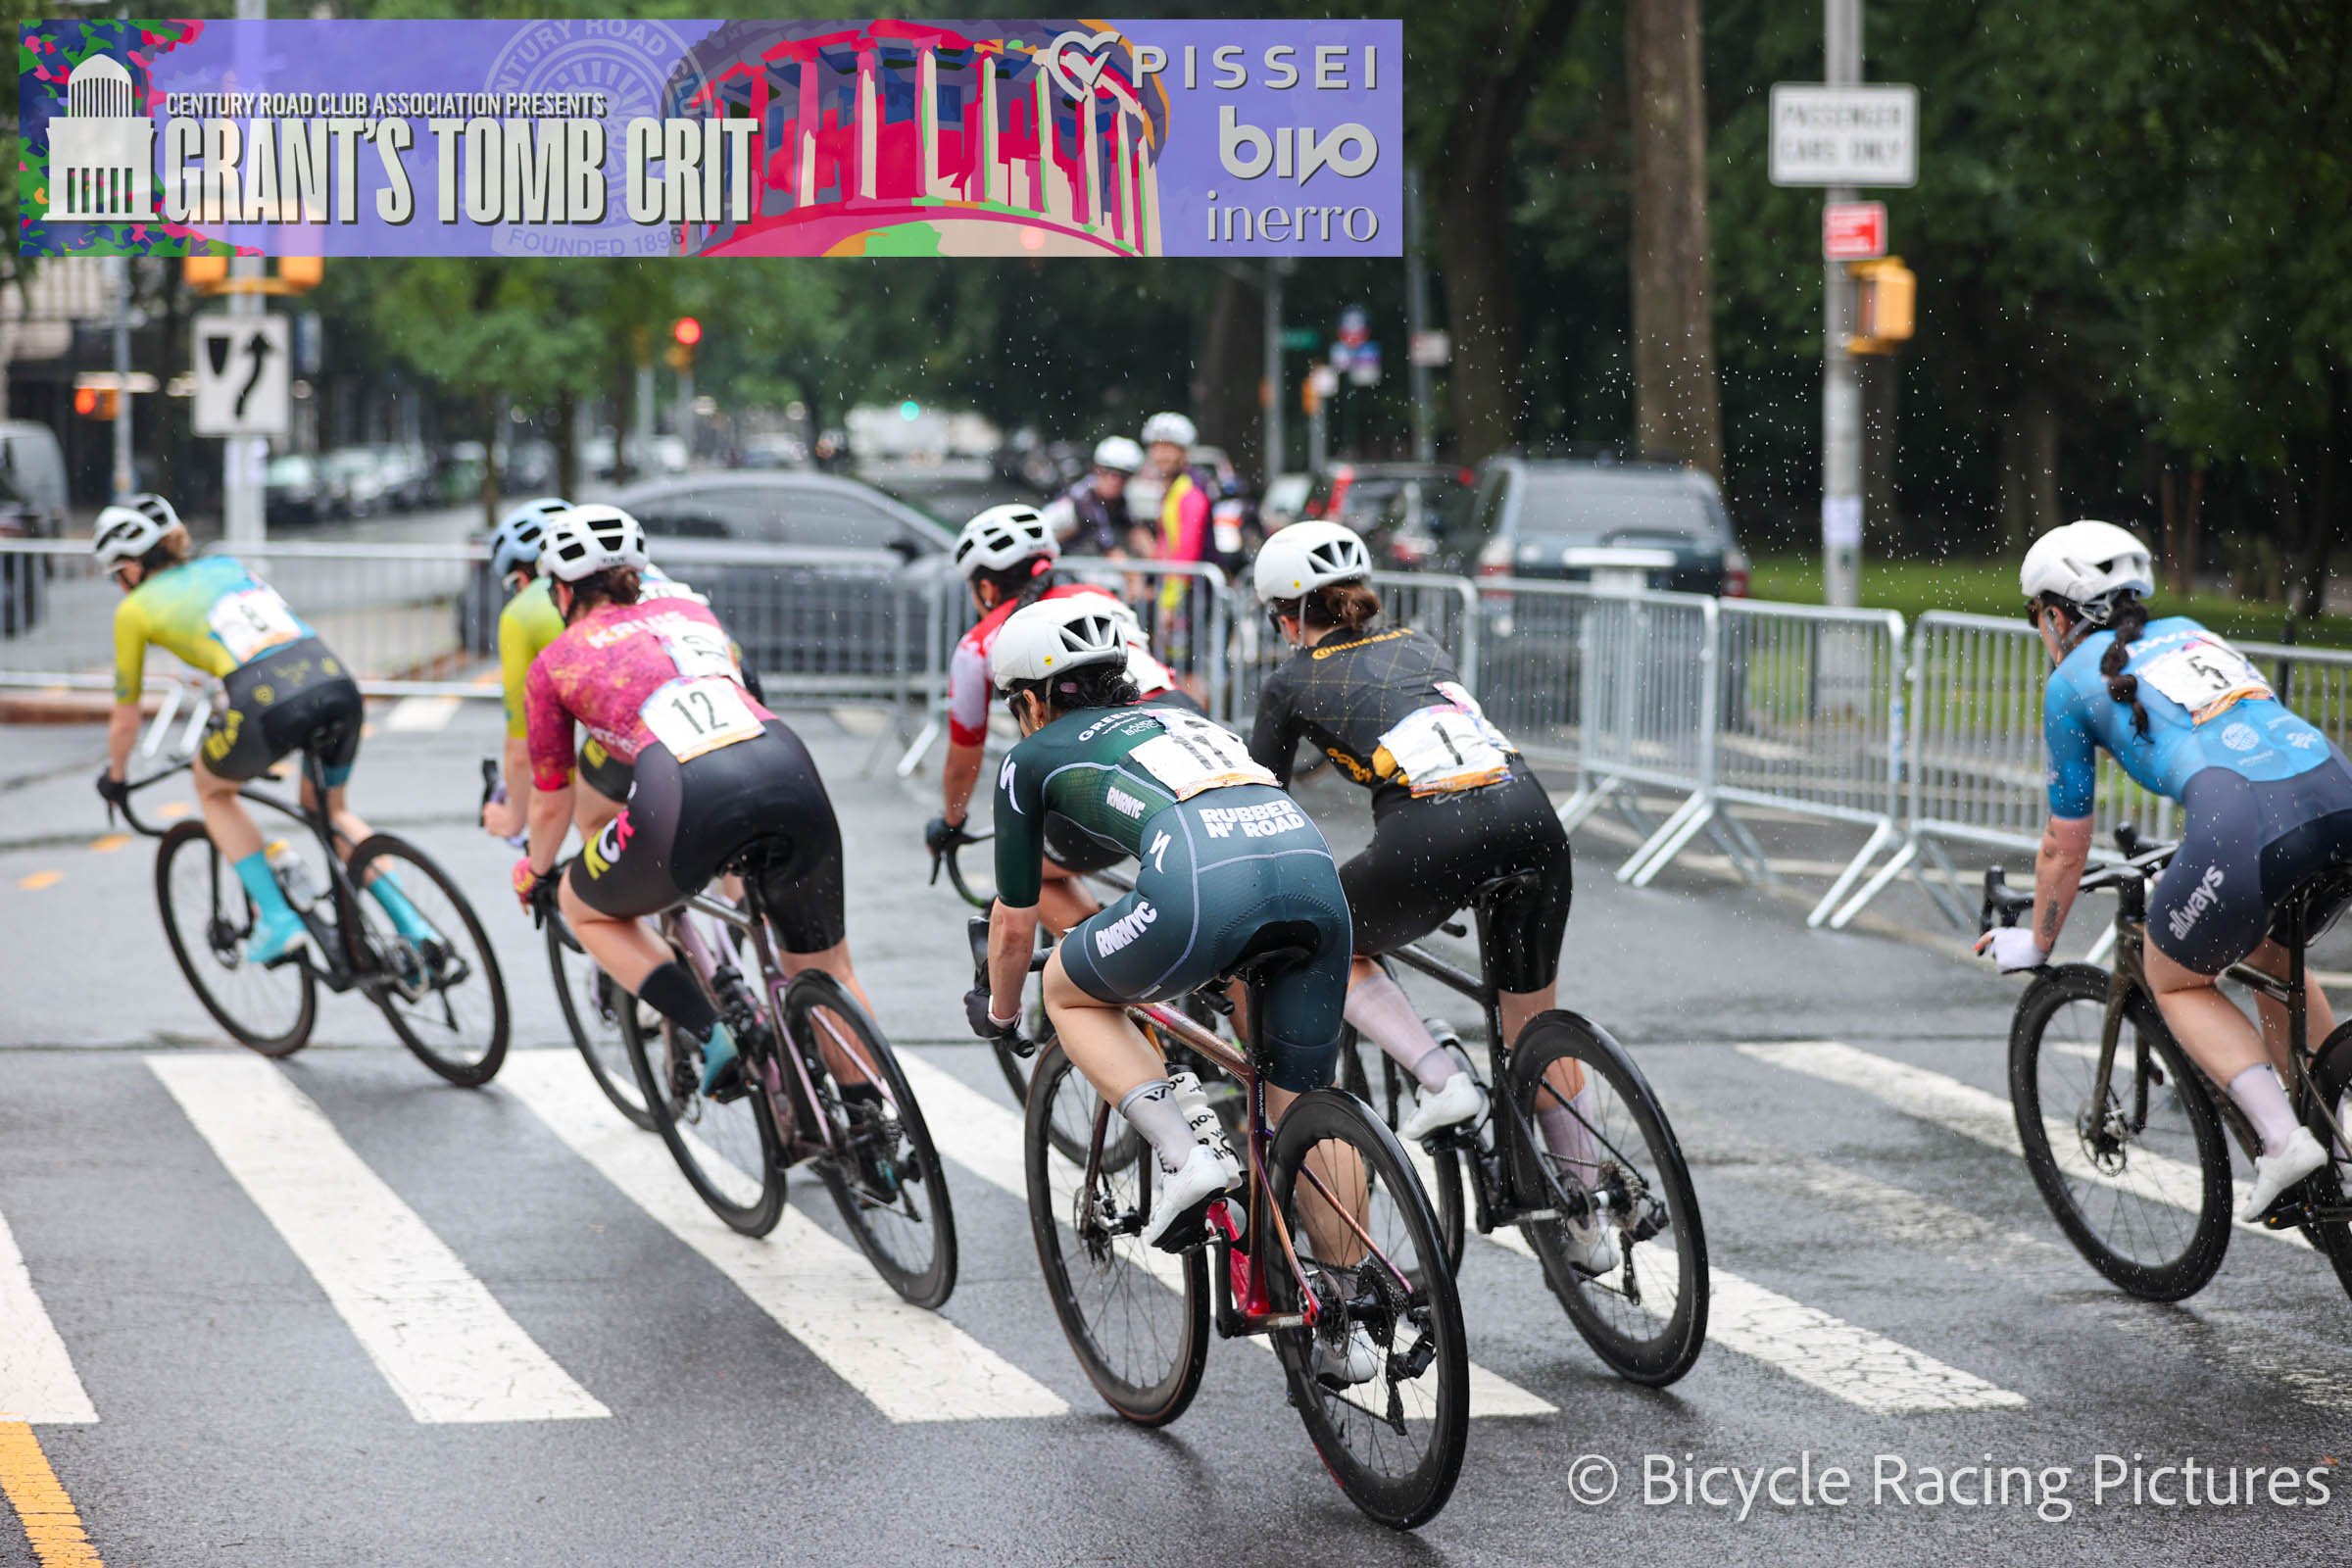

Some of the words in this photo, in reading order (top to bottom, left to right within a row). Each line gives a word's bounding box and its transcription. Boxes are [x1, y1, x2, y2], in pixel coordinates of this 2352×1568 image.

[2186, 655, 2231, 691] 5
[670, 690, 729, 735] 12
[1431, 721, 1463, 766] 1
[1198, 799, 1298, 823] RUBBER
[1240, 812, 1305, 838] ROAD
[1095, 901, 1157, 958] RNRNYC
